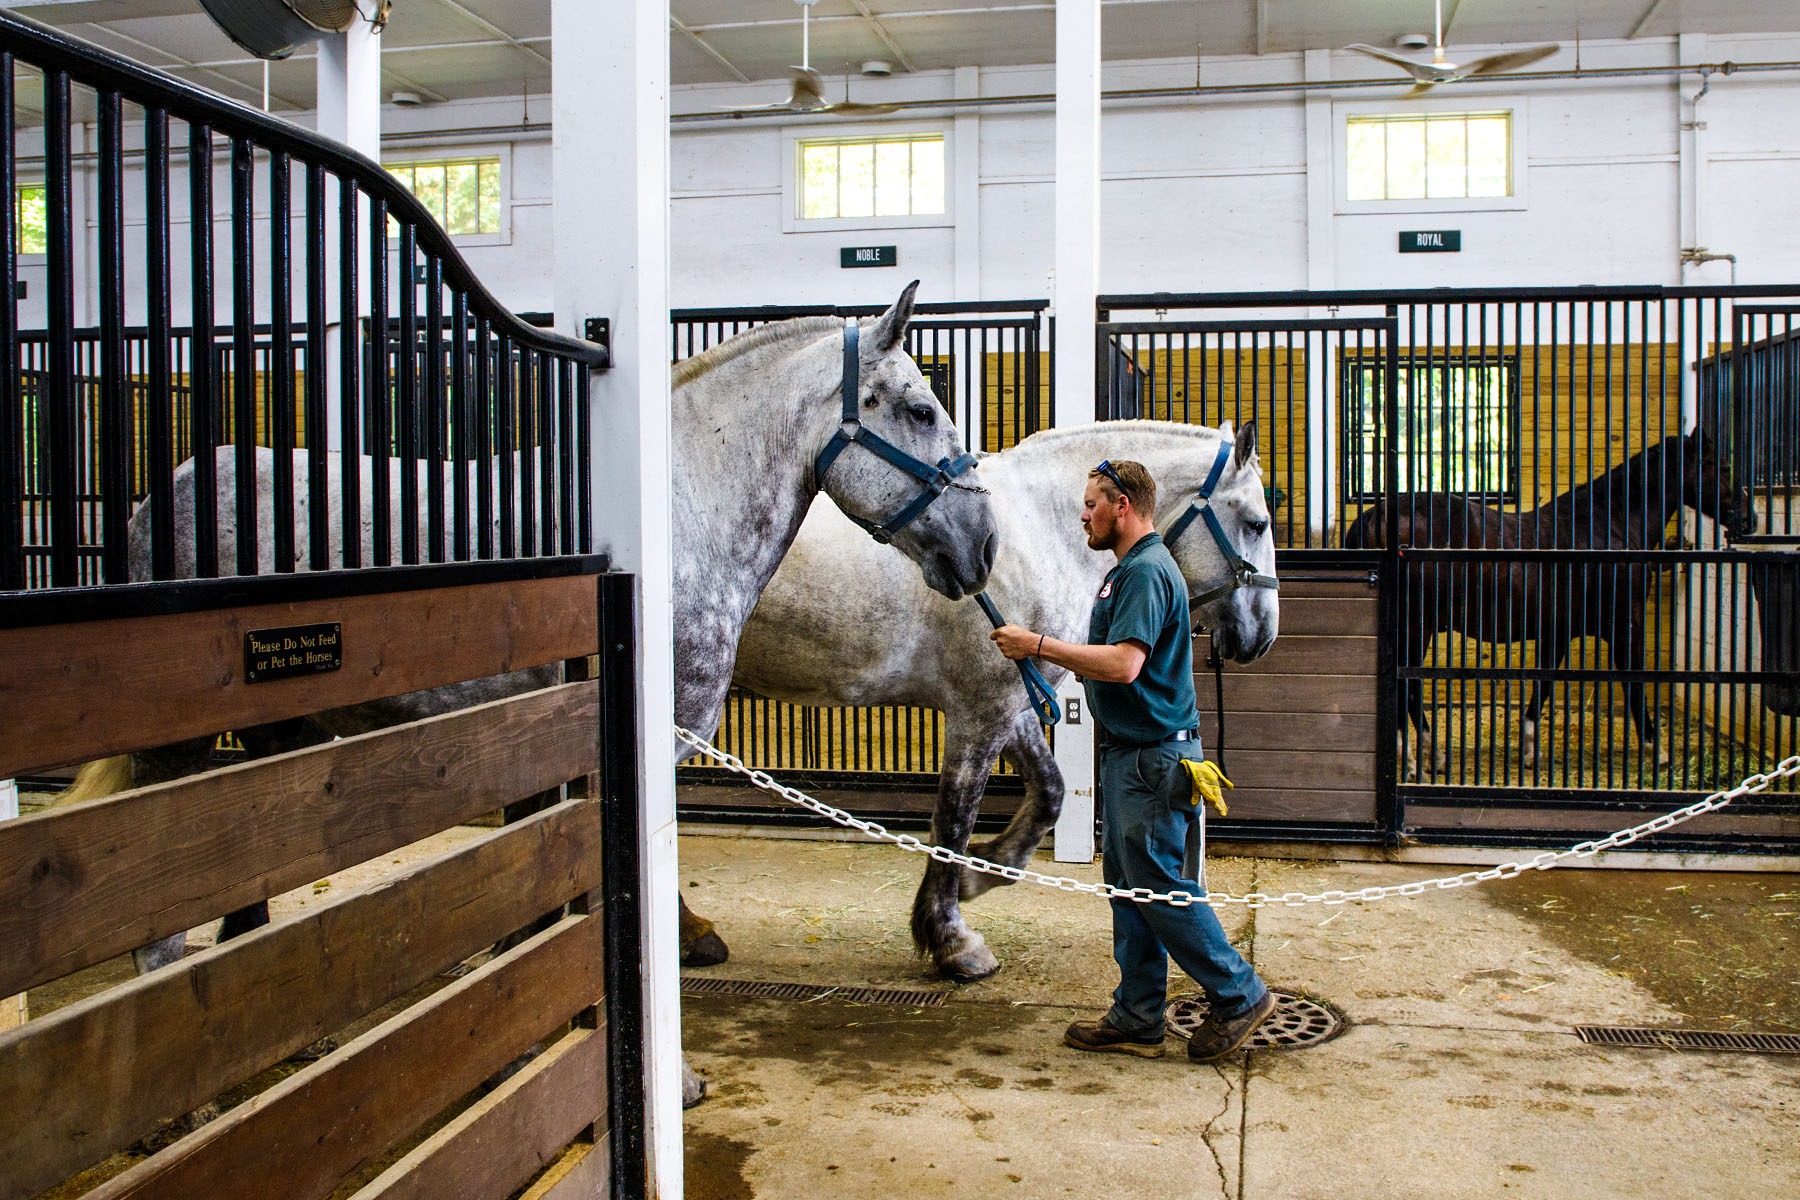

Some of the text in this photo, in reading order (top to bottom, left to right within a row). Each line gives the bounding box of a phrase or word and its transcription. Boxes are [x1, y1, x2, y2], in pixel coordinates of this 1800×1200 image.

[1417, 233, 1443, 246] ROYAL
[856, 248, 880, 262] NOBLE
[251, 633, 336, 654] Please Do Not Feed
[257, 651, 332, 670] or Pet the Horses
